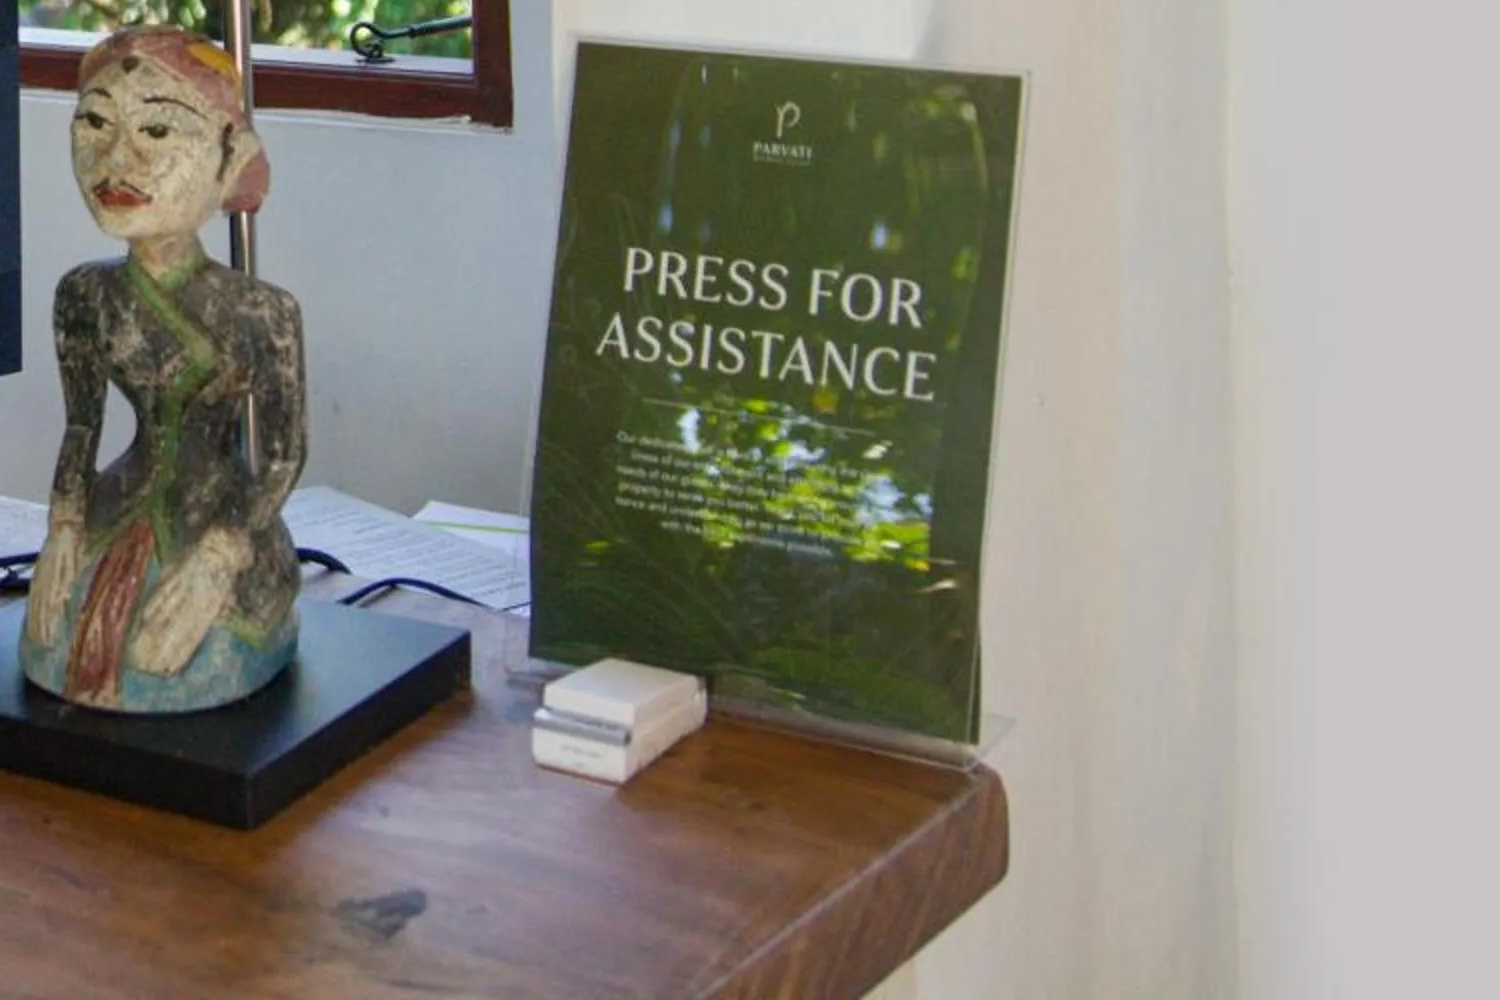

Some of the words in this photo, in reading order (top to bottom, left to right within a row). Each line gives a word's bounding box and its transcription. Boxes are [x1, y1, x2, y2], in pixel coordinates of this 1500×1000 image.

[753, 141, 812, 158] PARVATI
[623, 247, 789, 311] PRESS
[808, 268, 922, 328] FOR
[596, 312, 937, 401] ASSISTANCE
